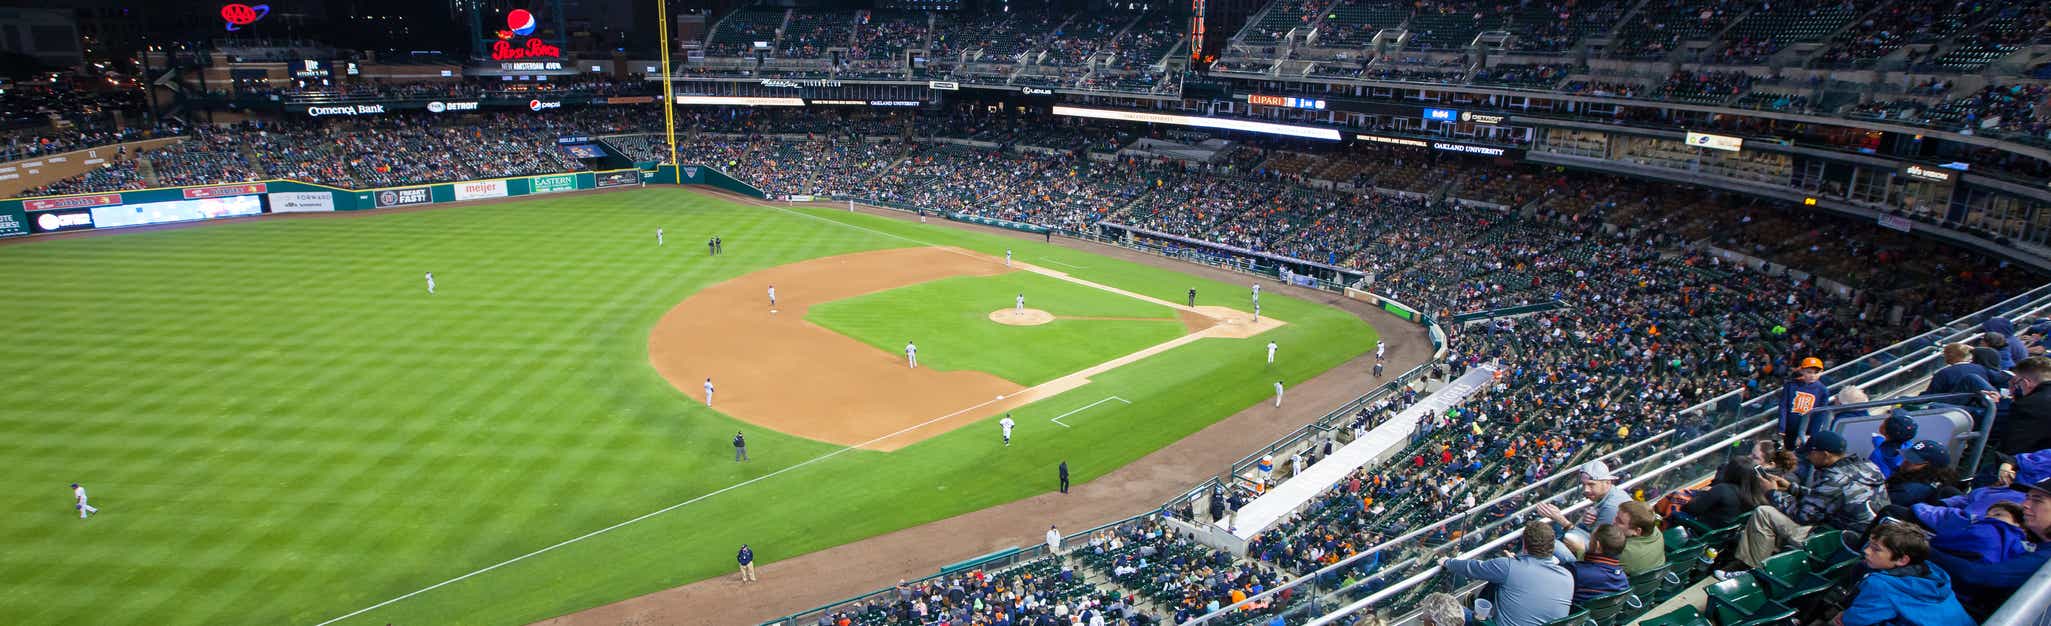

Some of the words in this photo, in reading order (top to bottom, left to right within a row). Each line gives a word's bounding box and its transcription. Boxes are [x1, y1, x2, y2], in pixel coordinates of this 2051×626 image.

[1253, 96, 1281, 105] LIPARI
[357, 104, 384, 113] Bank
[446, 102, 478, 111] DETROIT
[1434, 142, 1464, 151] OAKLAND
[1465, 146, 1504, 156] UNIVERSITY
[534, 176, 572, 186] EASTERN
[465, 181, 497, 193] meijer
